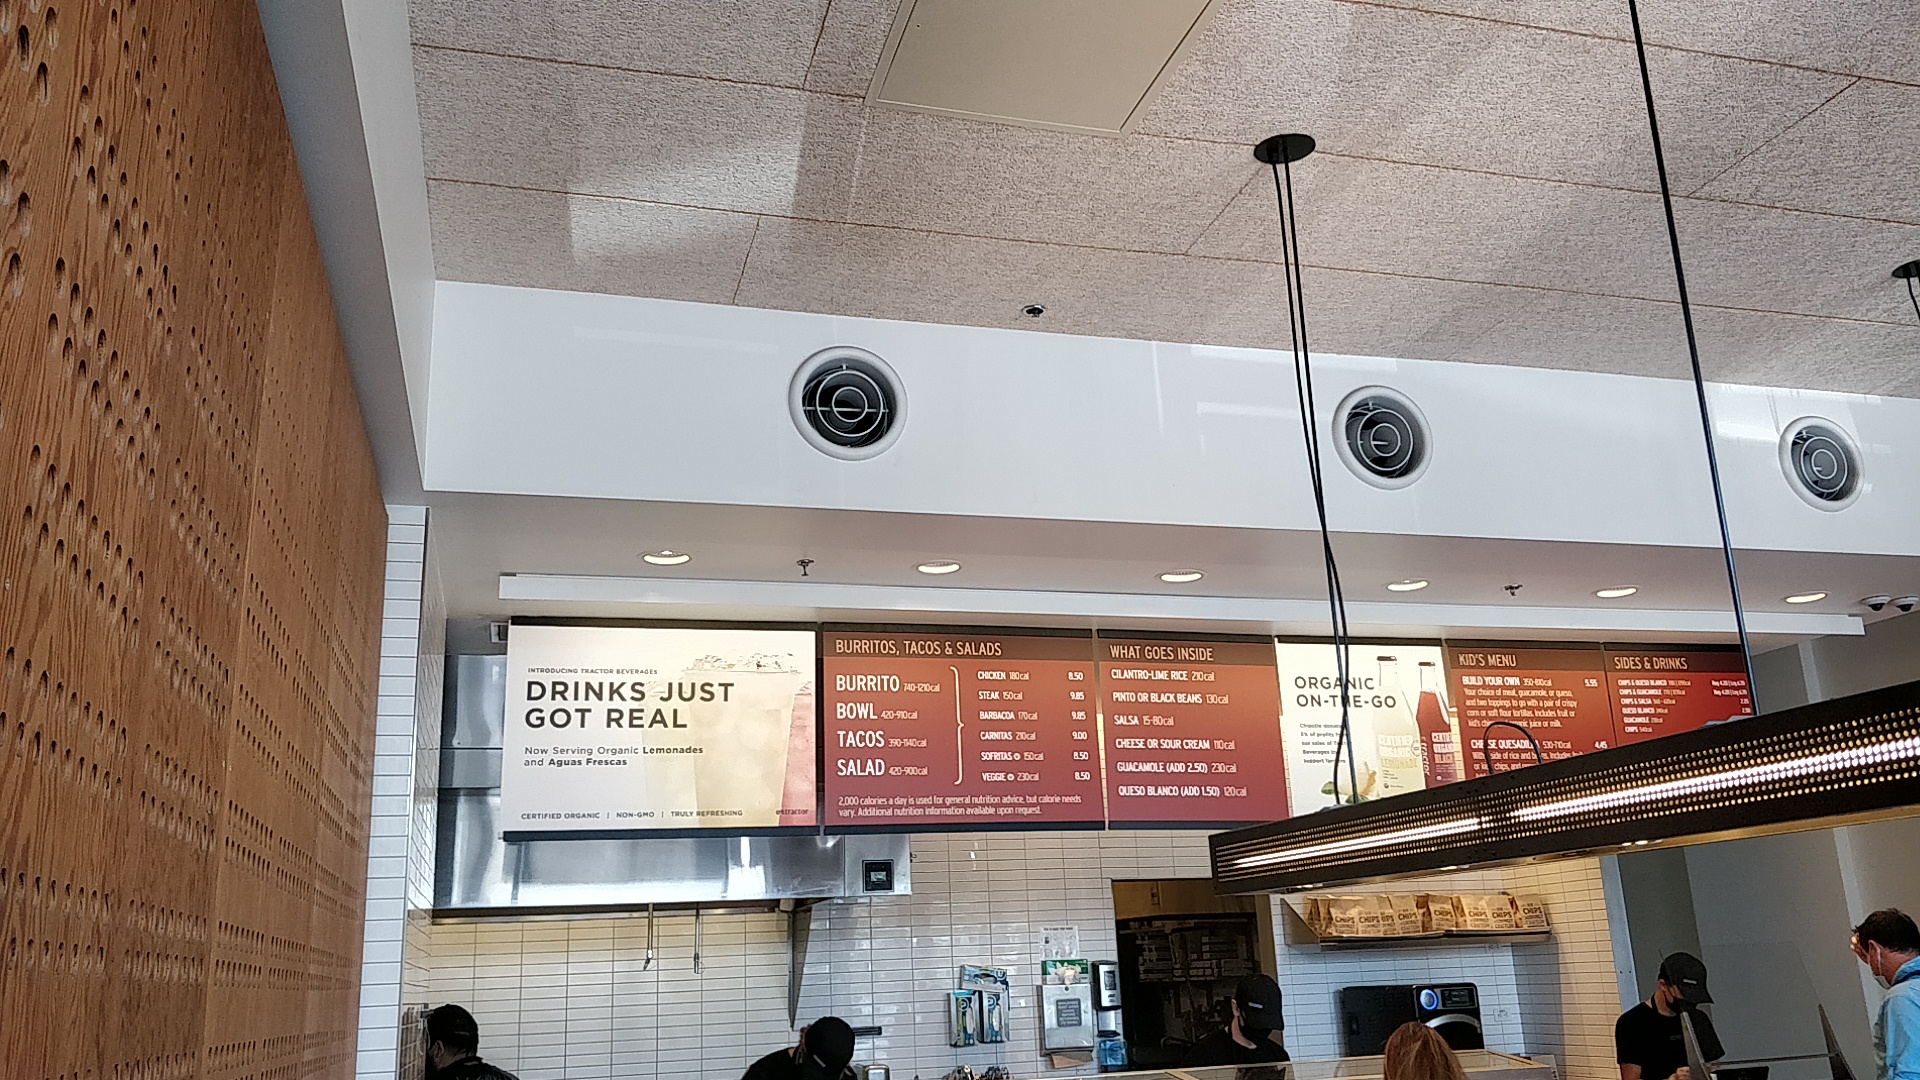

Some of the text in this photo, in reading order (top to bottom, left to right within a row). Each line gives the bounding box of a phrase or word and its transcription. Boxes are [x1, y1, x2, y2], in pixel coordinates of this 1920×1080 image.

[835, 639, 1002, 656] BURRITOS, TACOS & SALADS
[1109, 645, 1214, 661] WHAT GOES INSIDE
[1458, 653, 1517, 667] KID'S MENU
[1614, 656, 1688, 670] SIDES & DRINKS
[977, 671, 1006, 680] CHICKEN
[1068, 672, 1084, 680] 8.50
[1111, 669, 1169, 680] CILANTRO-LIME
[1170, 670, 1188, 681] RICE
[836, 675, 900, 692] BURRITO
[1462, 676, 1483, 686] BUILD
[1484, 676, 1503, 686] YOUR
[1504, 677, 1521, 686] OWN
[527, 680, 735, 702] DRINKS JUST
[978, 691, 1000, 700] STEAK
[1070, 691, 1085, 700] 9.85
[1112, 692, 1136, 702] PINTO
[1137, 692, 1149, 703] OR
[1150, 692, 1175, 703] BLACK
[1177, 693, 1202, 704] BEANS
[1512, 698, 1518, 706] to
[1561, 699, 1578, 708] crispy
[836, 702, 878, 719] BOWL
[979, 711, 1015, 720] BARBACOA
[1071, 711, 1086, 720] 9.85
[525, 708, 687, 729] GOT REAL
[1113, 715, 1139, 725] SALSA
[837, 730, 885, 748] TACOS
[980, 731, 1013, 740] CARNITAS
[1072, 731, 1088, 740] 9.00
[1115, 738, 1146, 748] CHEESE
[1147, 738, 1159, 749] OR
[1160, 739, 1182, 749] SOUR
[1183, 739, 1210, 750] CREAM
[1470, 739, 1498, 749] CHESE
[524, 745, 704, 757] Now Serving Organic Lemonades
[981, 751, 1012, 760] SOFRITAS
[1073, 751, 1089, 760] 8.50
[524, 757, 627, 767] and Aguas Frescas
[837, 758, 885, 776] SALAD
[1117, 762, 1165, 772] GUACAMOLE
[1166, 762, 1186, 773] (ADD
[1187, 762, 1208, 773] 2.50)
[982, 773, 1007, 781] VEGGIE
[1075, 771, 1091, 780] 8.50
[1118, 786, 1146, 797] QUESO
[1147, 786, 1179, 797] BLANCO
[1180, 786, 1200, 797] (ADD
[1201, 786, 1220, 797] 1.50)
[860, 796, 887, 805] calories
[888, 797, 893, 805] a
[894, 796, 907, 806] day
[908, 795, 915, 804] is
[916, 795, 932, 804] used
[933, 795, 943, 804] for
[945, 795, 970, 806] general
[972, 794, 1000, 803] nutrition
[1002, 794, 1025, 804] advice,
[1026, 794, 1037, 803] but
[1038, 794, 1061, 803] calorie
[1062, 794, 1082, 803] needs
[521, 812, 562, 820] CERTIFIED
[696, 809, 744, 817] REFRESHING
[839, 805, 1042, 818] vary. Additional nutrition information available upon request.
[1398, 912, 1417, 920] CHIPS
[1491, 911, 1513, 919] CHIPS
[1523, 907, 1542, 915] CHIPS
[1335, 915, 1355, 923] CHIPS
[1359, 915, 1380, 923] CHIPS
